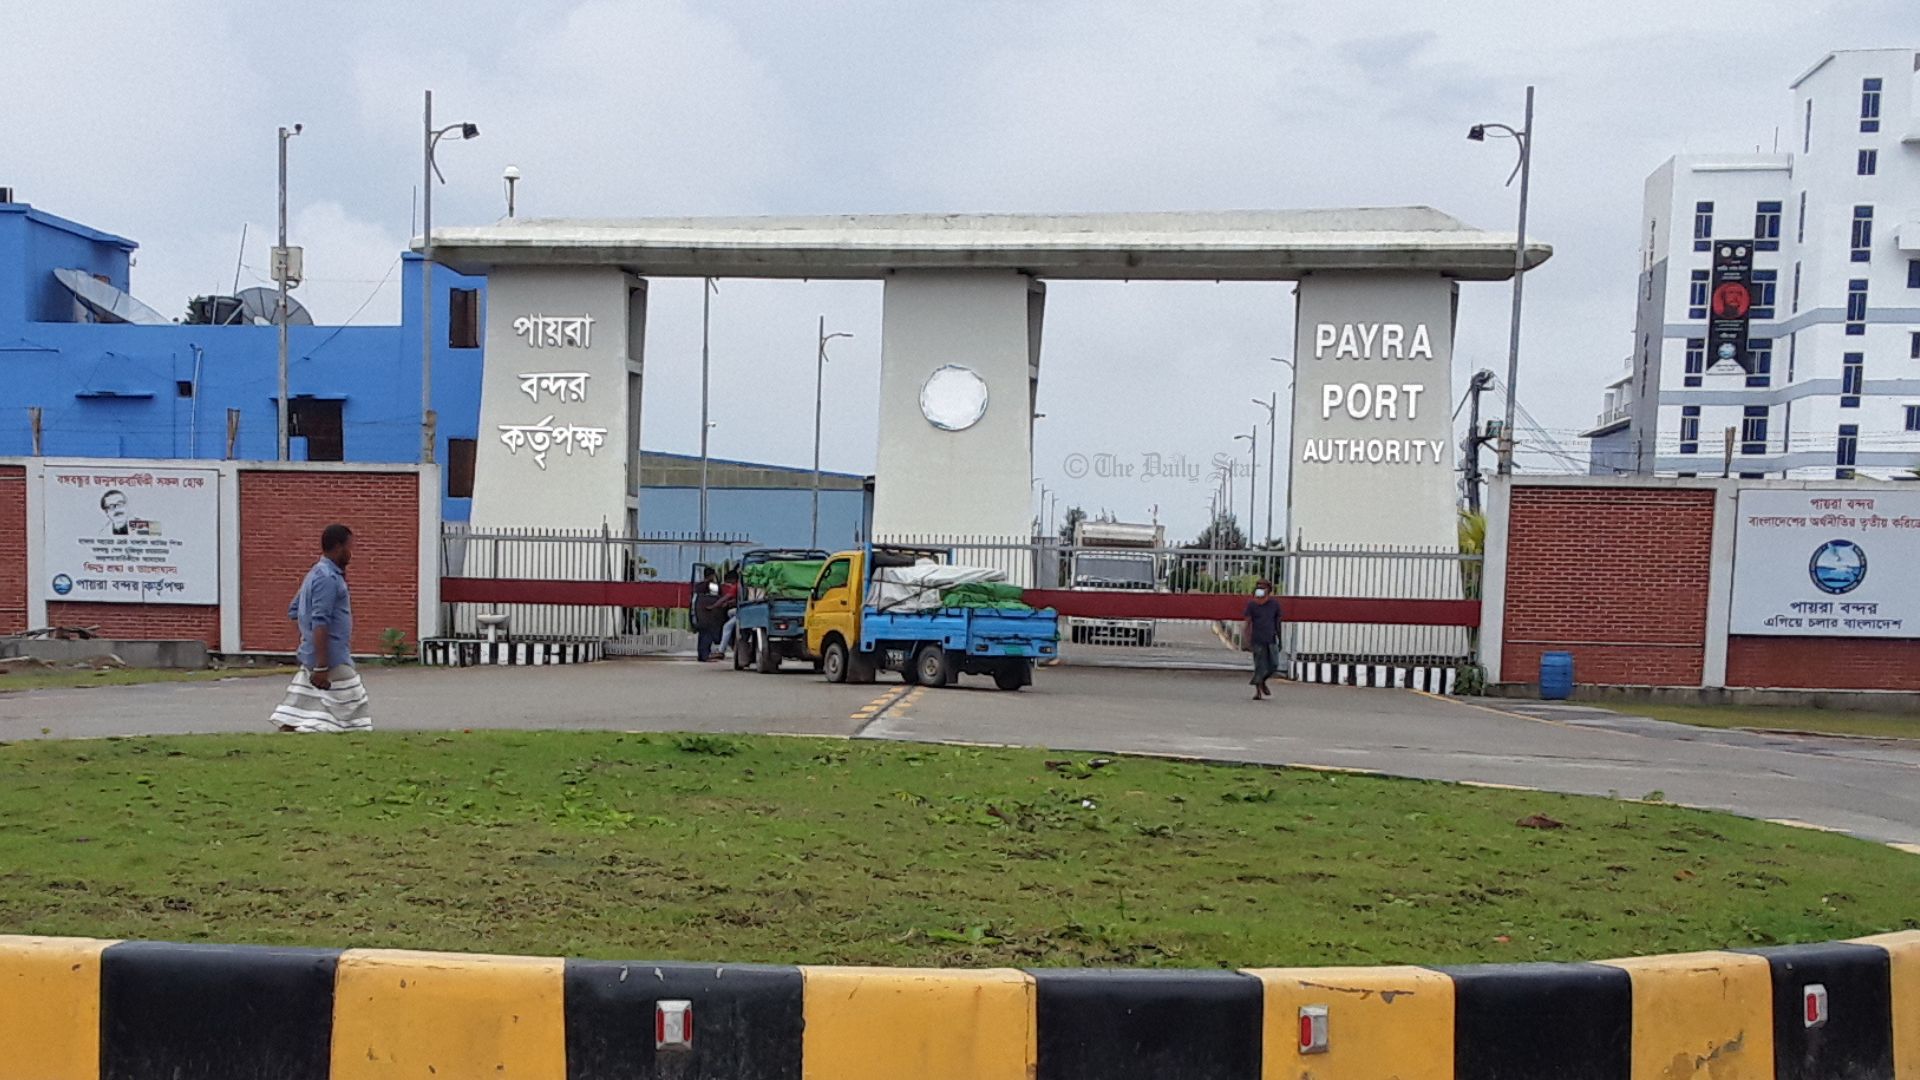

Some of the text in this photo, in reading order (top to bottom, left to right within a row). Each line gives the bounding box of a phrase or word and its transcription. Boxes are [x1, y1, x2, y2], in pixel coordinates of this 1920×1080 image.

[513, 313, 596, 348] পায়রা
[1315, 323, 1433, 360] PAYRA
[518, 371, 591, 403] বন্দর
[1322, 383, 1424, 420] PORT
[498, 415, 608, 470] কর্তৃপক্ষ
[1303, 439, 1445, 464] AUTHORITY
[182, 476, 205, 489] হোক
[1810, 498, 1875, 510] পায়রা বন্দর
[1748, 516, 1806, 528] বাংলাদেশের
[1810, 514, 1856, 528] অর্থনীতির
[1860, 514, 1888, 531] তৃতীয়
[76, 578, 185, 596] পায়রা বন্দর কর্তৃপক্ষ
[1790, 601, 1879, 615] পায়রা বন্দর
[1764, 614, 1803, 628] এগিয়ে
[1843, 618, 1903, 630] বাংলাদেশ
